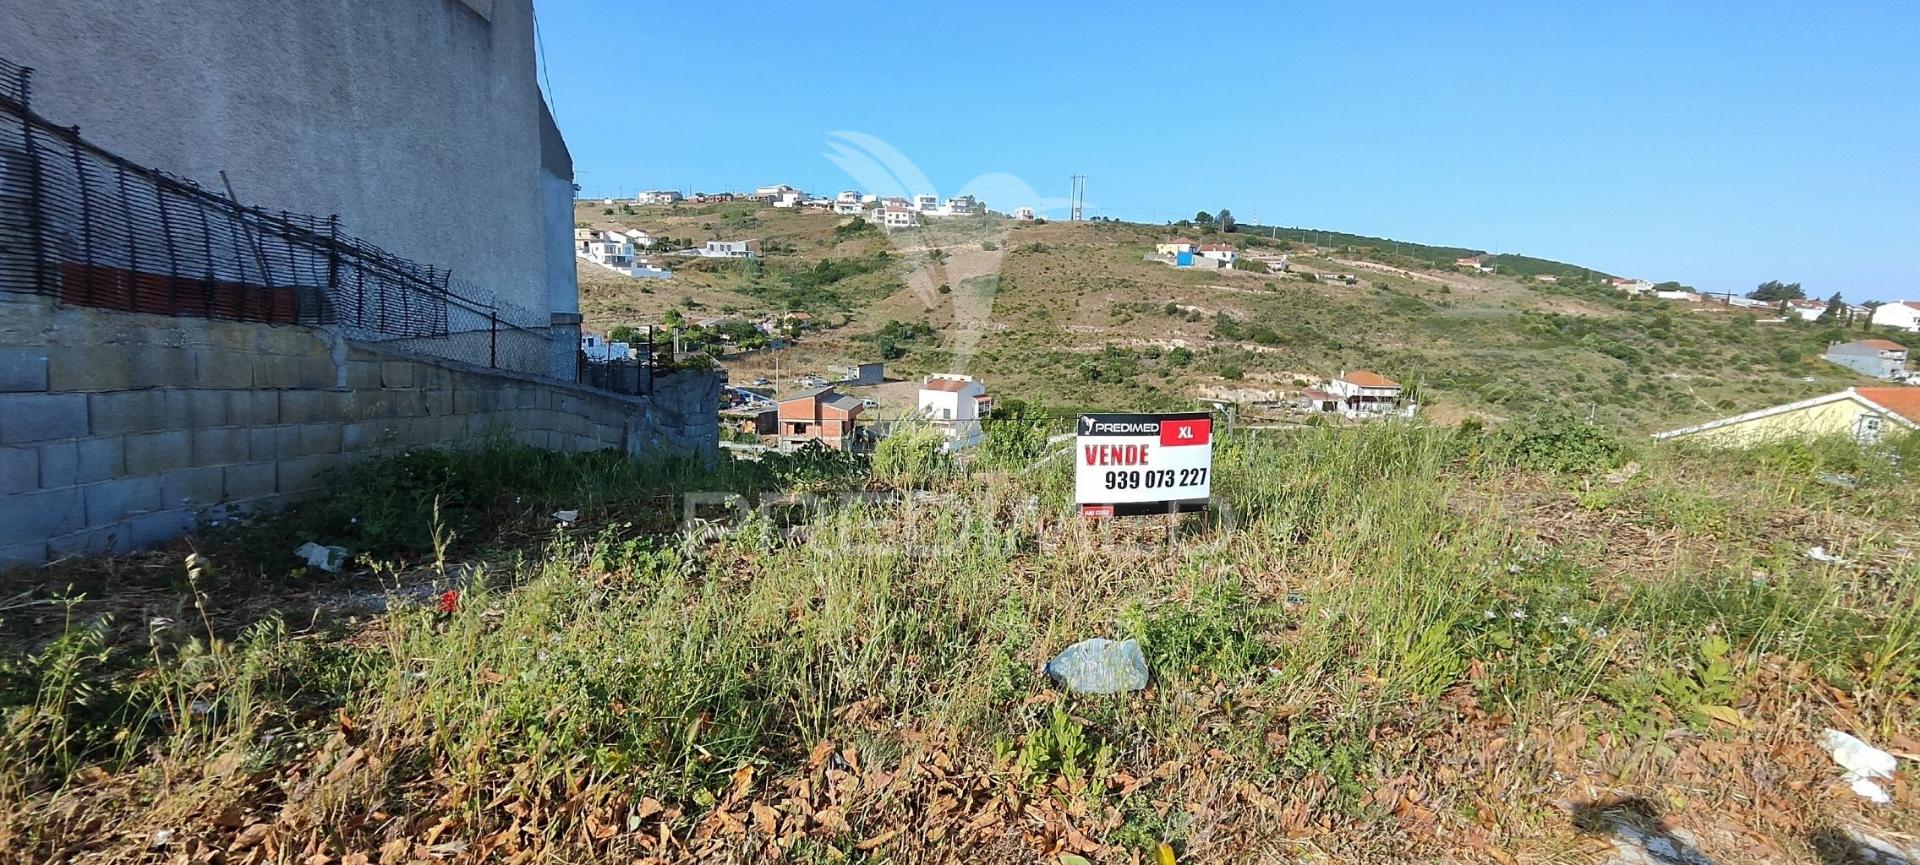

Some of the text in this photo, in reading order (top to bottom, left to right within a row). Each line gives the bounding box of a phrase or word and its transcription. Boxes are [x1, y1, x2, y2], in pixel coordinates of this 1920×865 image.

[1095, 423, 1159, 433] PREDIMED
[1177, 426, 1194, 439] XL
[1084, 444, 1149, 466] VENDE
[1105, 467, 1207, 490] 939 073 227
